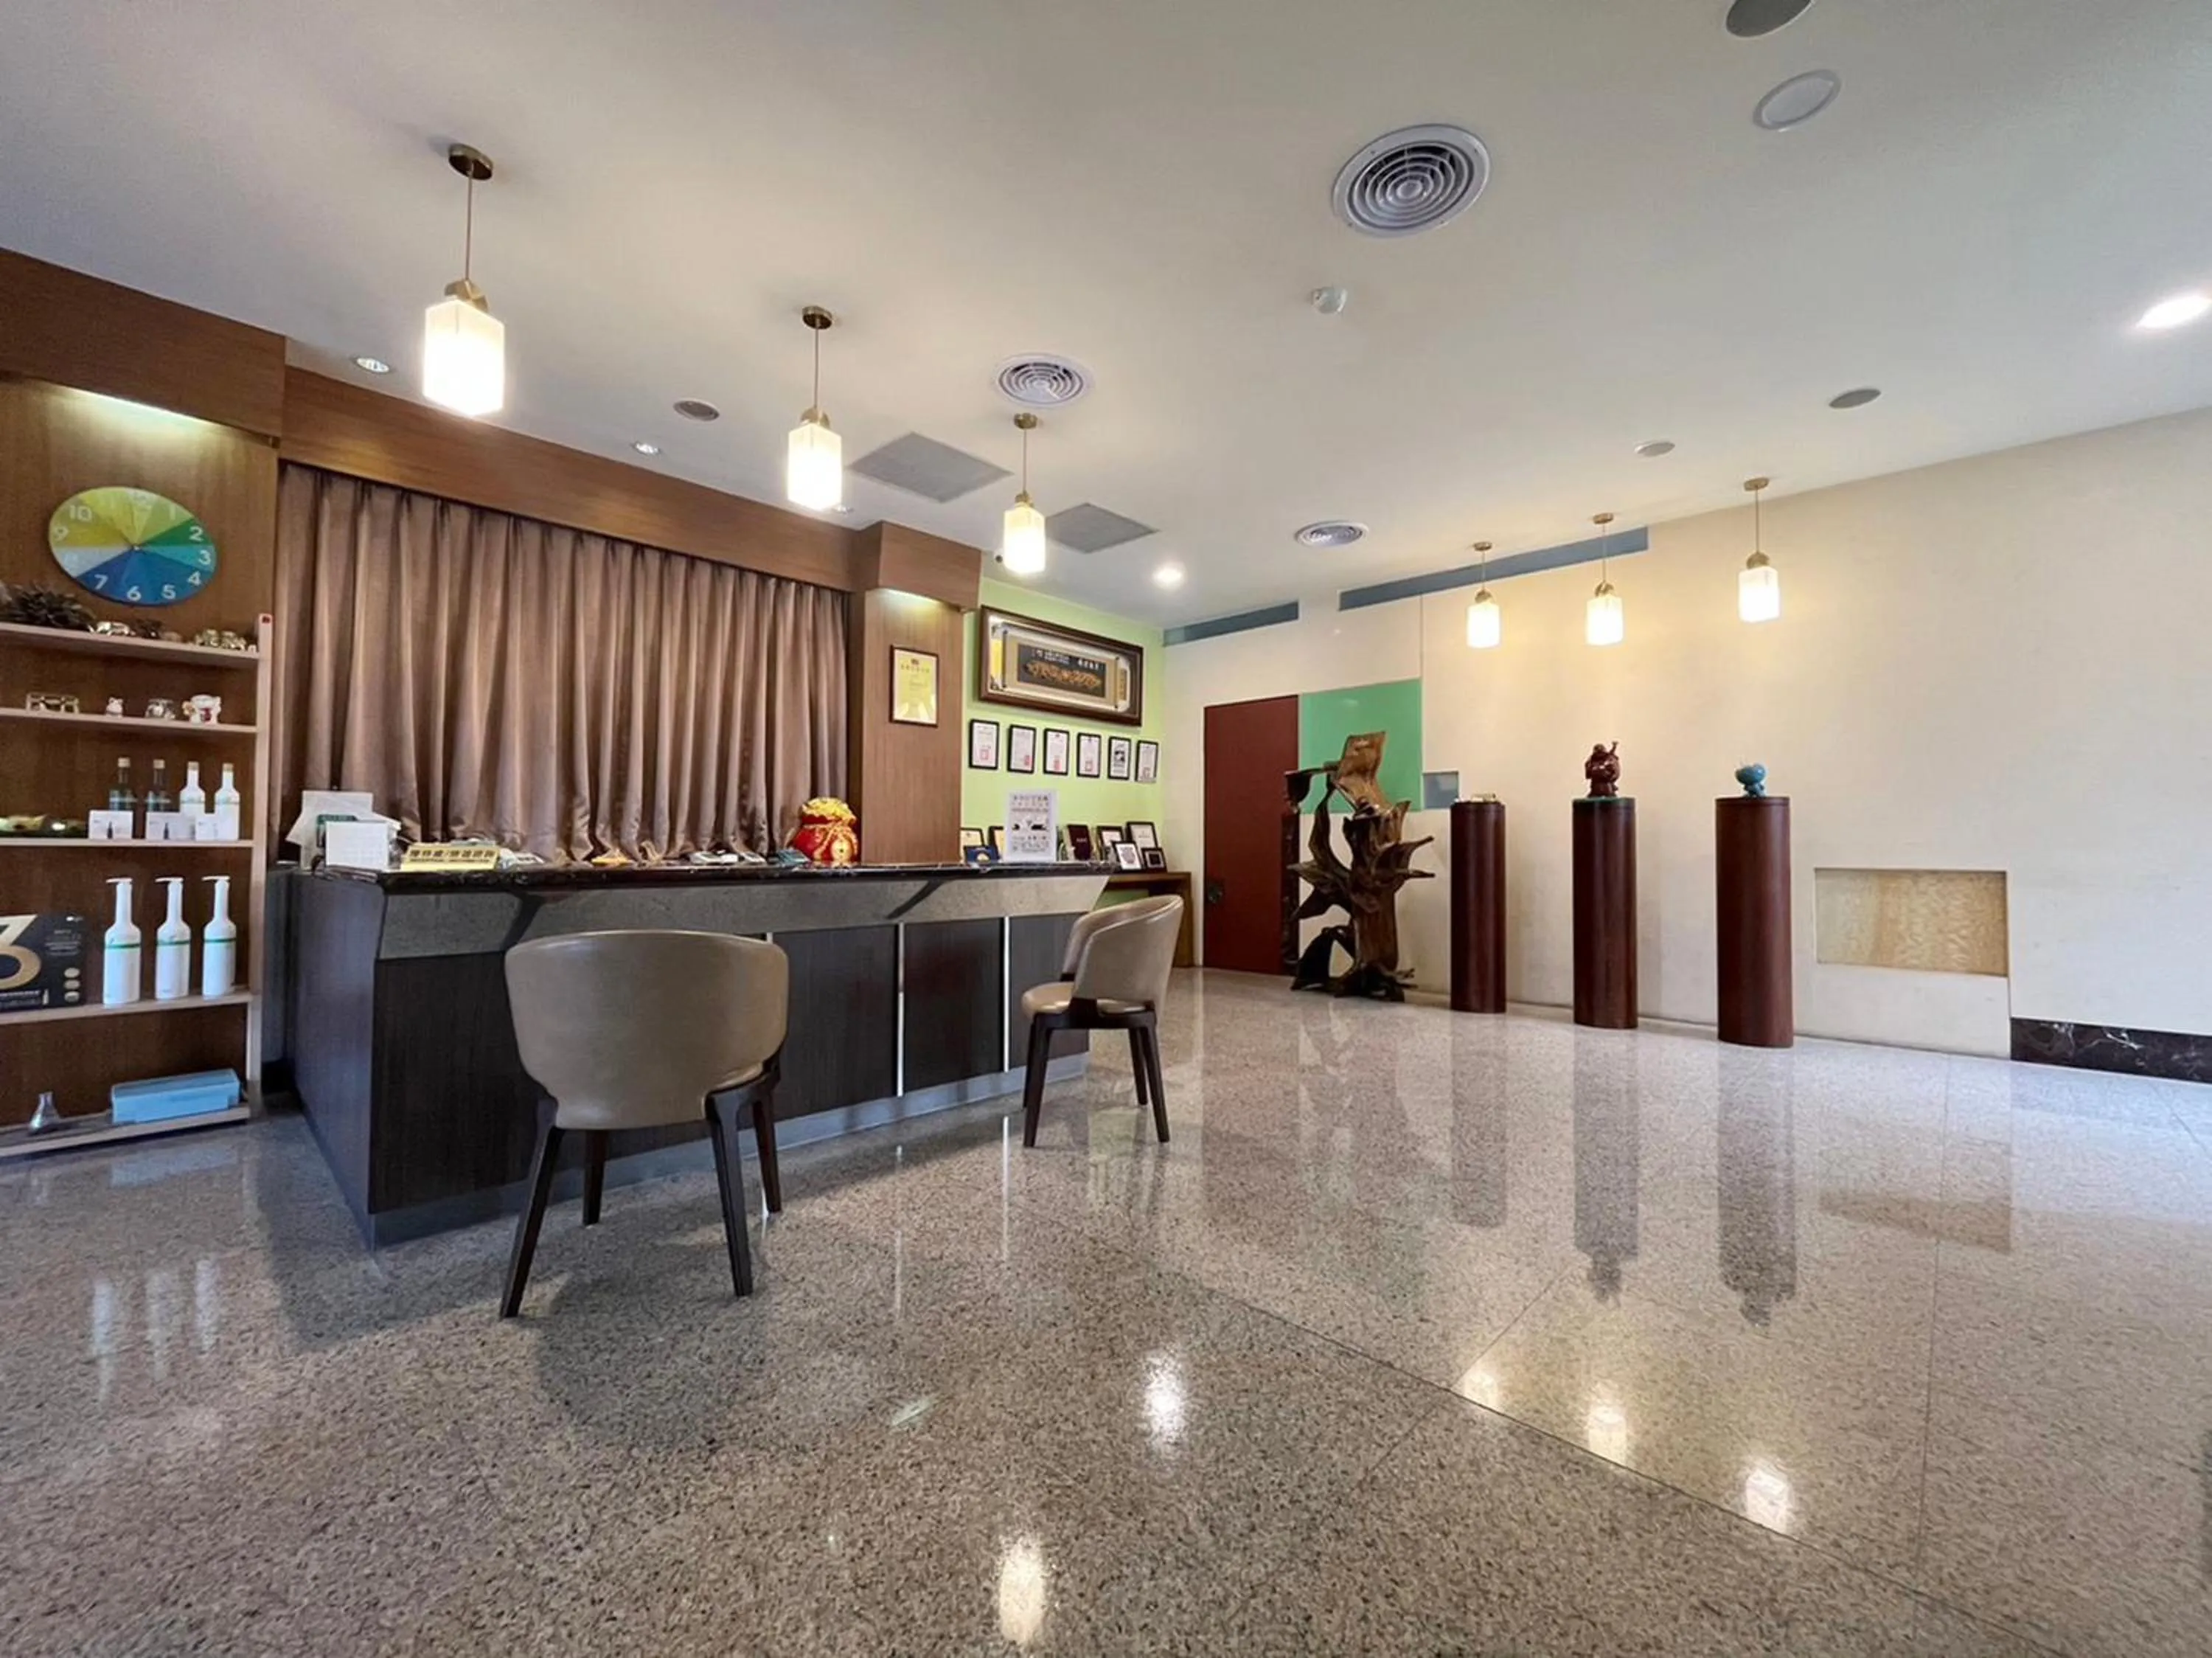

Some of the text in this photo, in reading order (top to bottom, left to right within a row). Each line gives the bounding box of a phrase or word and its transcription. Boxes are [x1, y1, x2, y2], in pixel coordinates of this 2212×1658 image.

[69, 504, 93, 521] 10
[55, 525, 69, 541] 9
[189, 526, 204, 541] 2
[198, 550, 212, 565] 3
[94, 575, 108, 589] 7
[187, 571, 201, 586] 4
[126, 586, 142, 601] 6
[161, 585, 176, 600] 5
